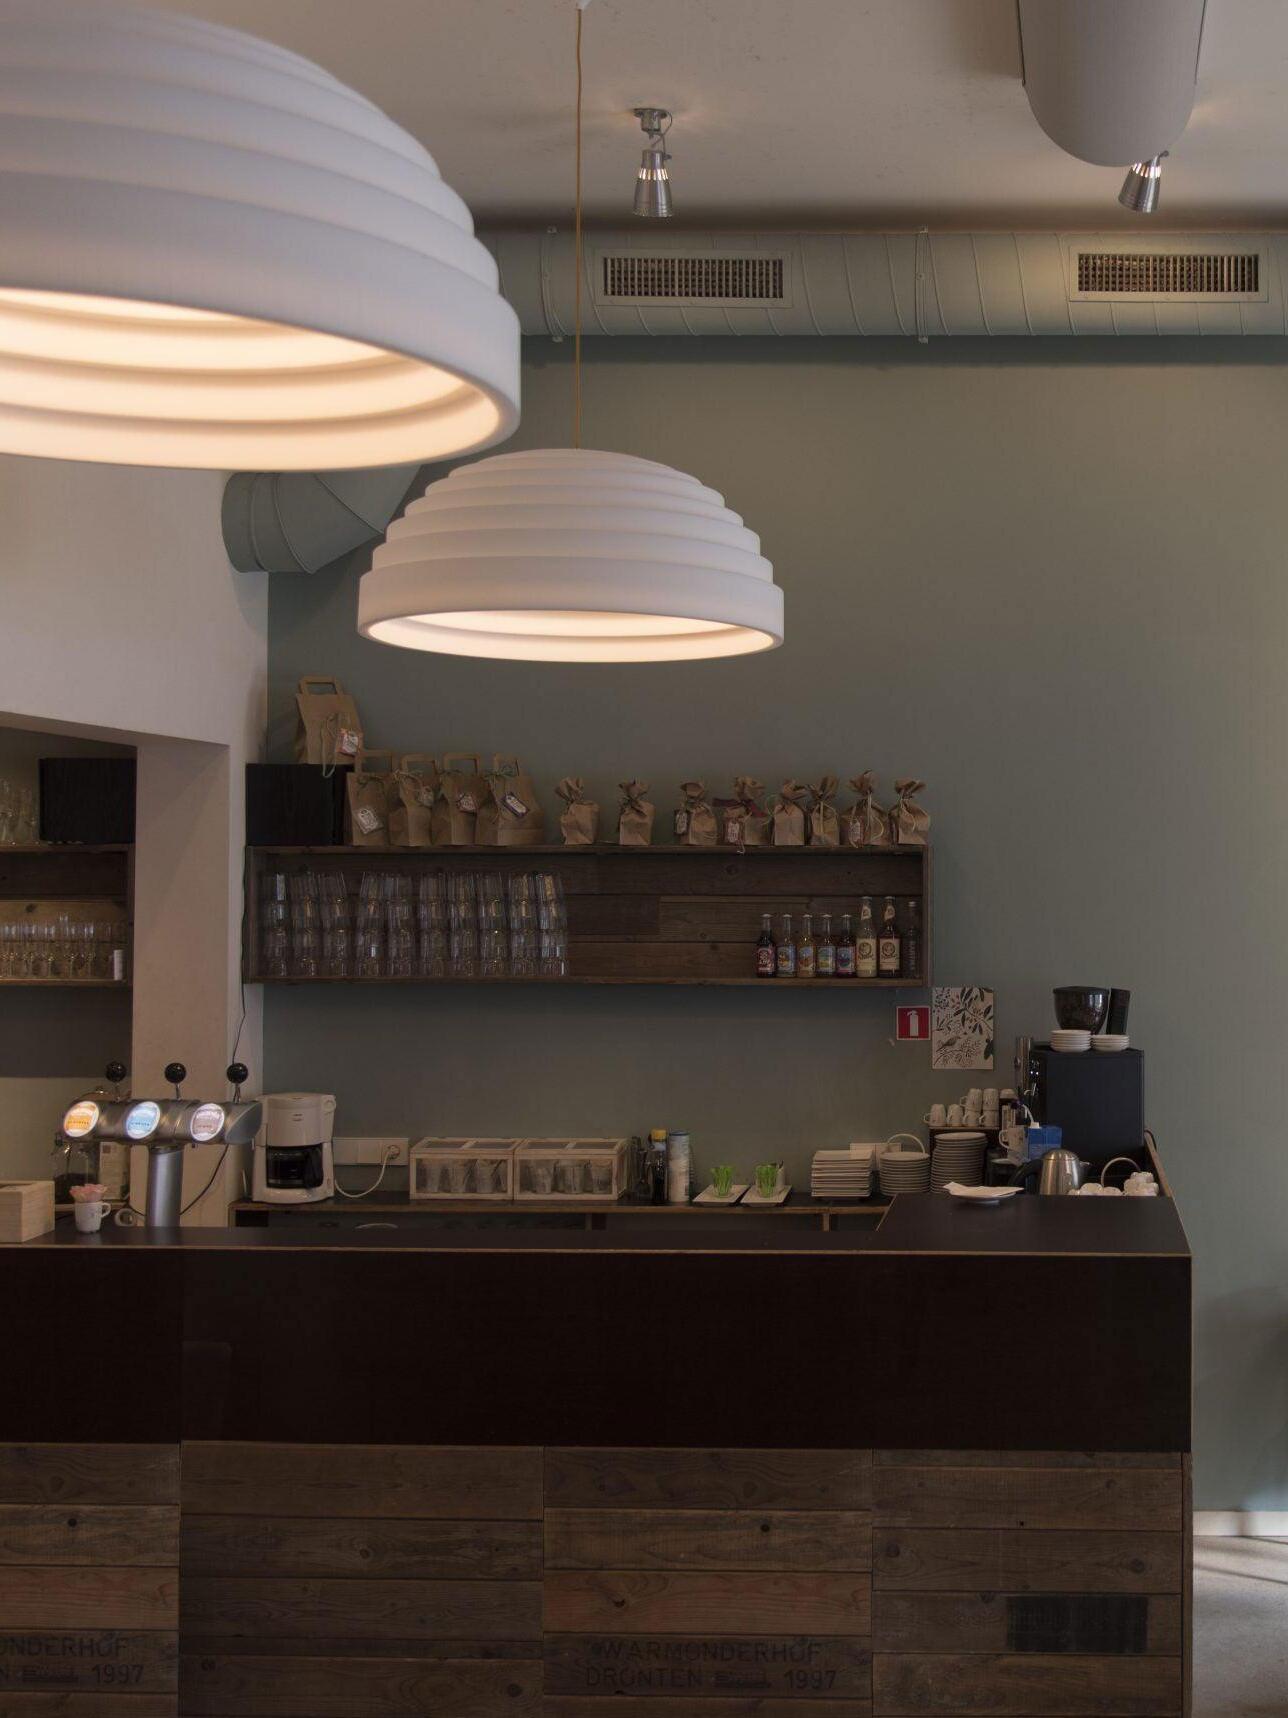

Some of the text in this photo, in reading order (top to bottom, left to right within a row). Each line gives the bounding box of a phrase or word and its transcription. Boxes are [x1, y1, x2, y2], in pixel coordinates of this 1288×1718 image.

[603, 1640, 821, 1662] WARMONDERHOF
[91, 1663, 144, 1683] 1997
[586, 1667, 837, 1689] DRONTEN 1997
